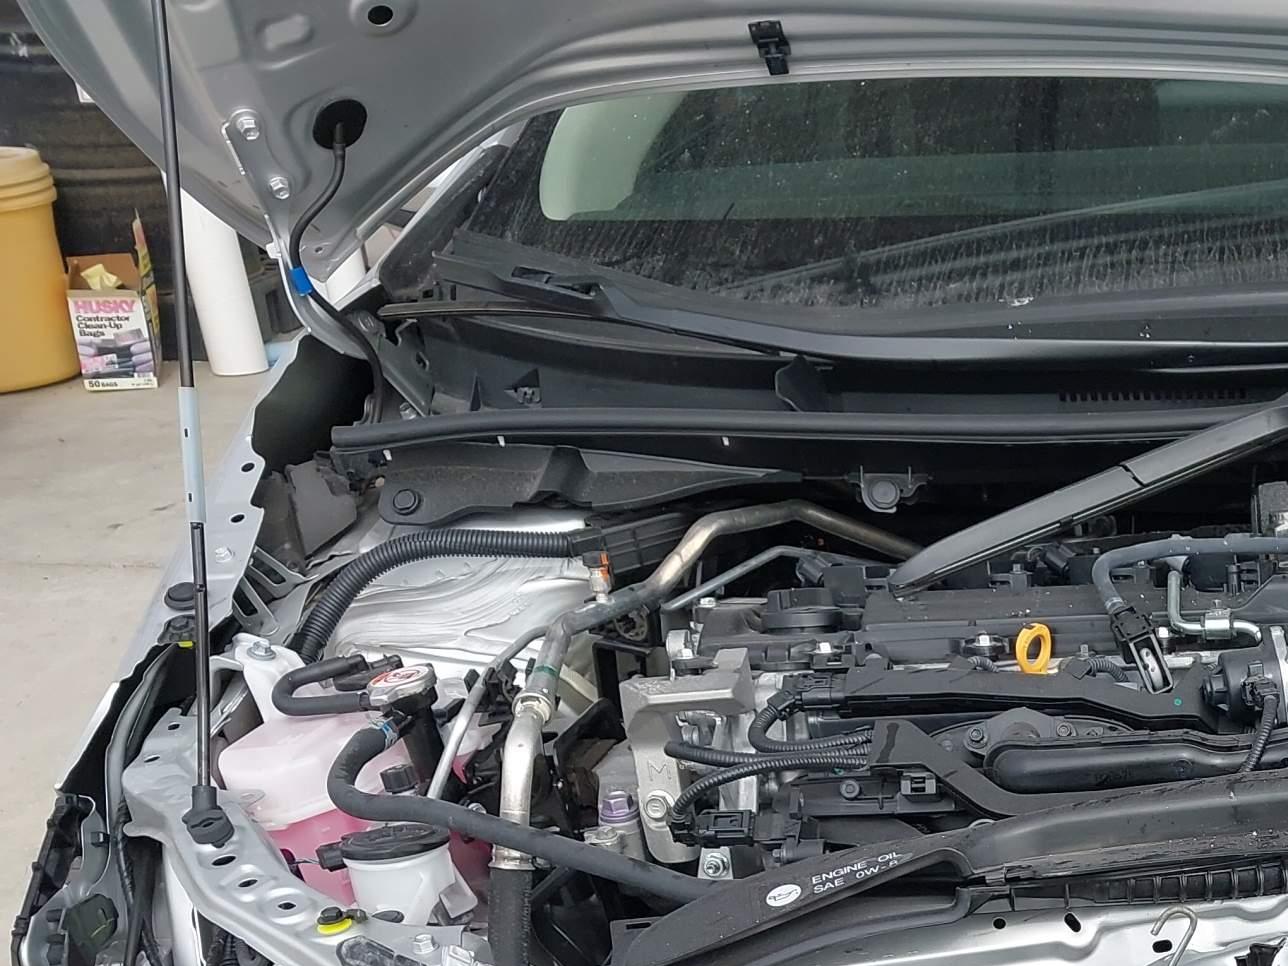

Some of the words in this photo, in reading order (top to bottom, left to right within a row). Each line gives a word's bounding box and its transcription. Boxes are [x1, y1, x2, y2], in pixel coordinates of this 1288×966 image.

[74, 299, 136, 313] HUSKY
[77, 322, 123, 330] Clean-Up
[79, 329, 106, 337] Bags
[88, 380, 101, 388] 50
[811, 860, 868, 885] ENGINE
[877, 851, 902, 863] OIL
[813, 877, 845, 894] SAE
